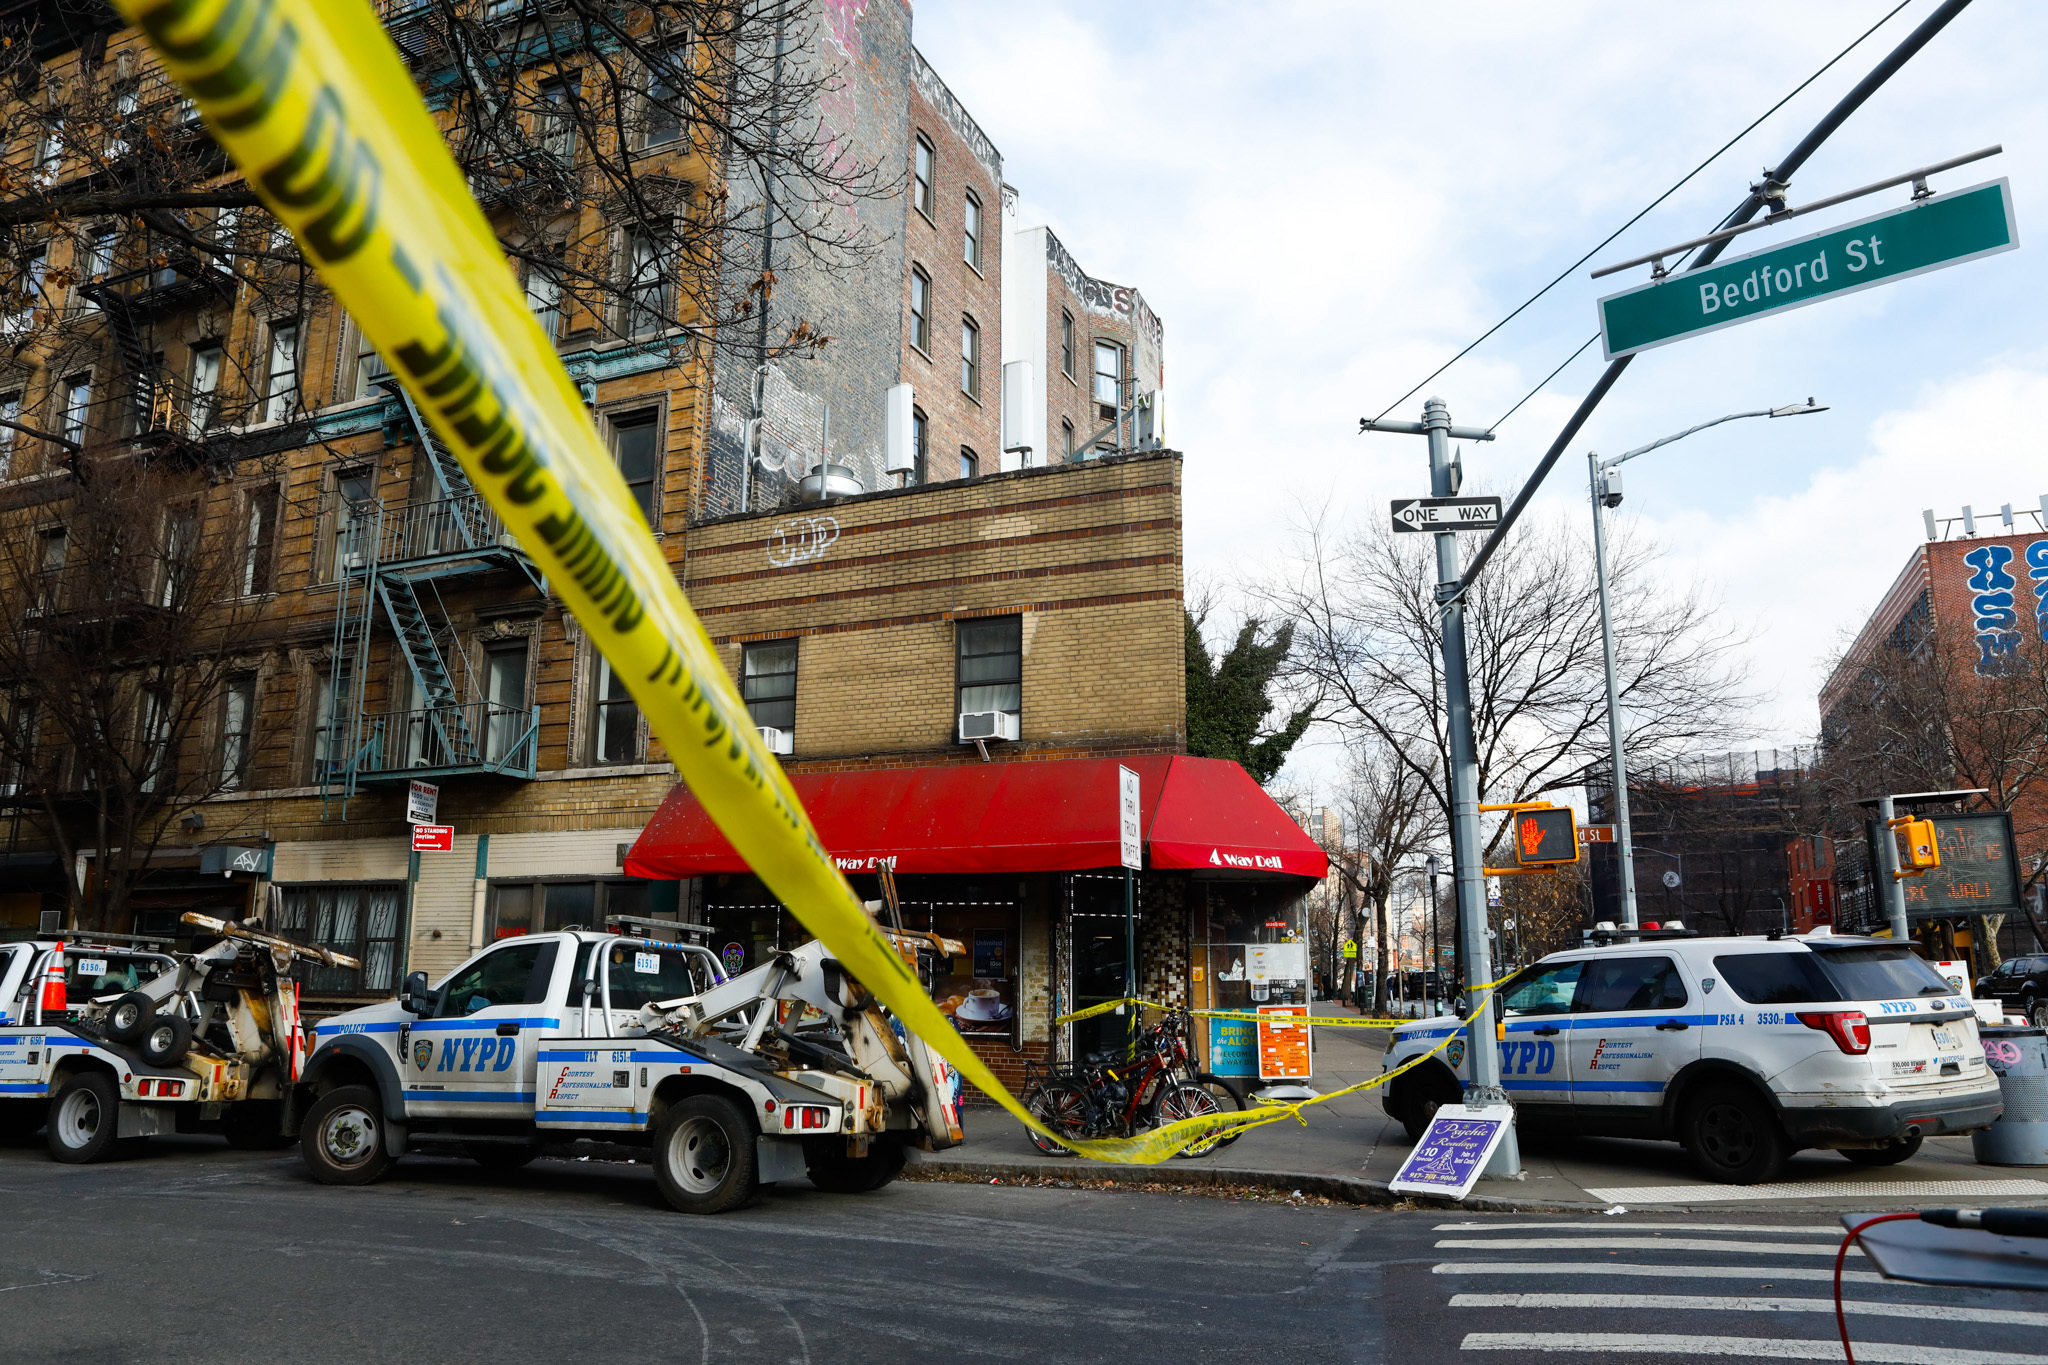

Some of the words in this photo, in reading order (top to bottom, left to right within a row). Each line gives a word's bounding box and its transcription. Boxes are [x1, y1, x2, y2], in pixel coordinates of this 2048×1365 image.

[1700, 250, 1828, 315] Bedford
[1845, 234, 1885, 273] St
[1403, 508, 1439, 523] ONE
[1458, 506, 1492, 521] WAY
[411, 783, 422, 793] FOR
[423, 786, 438, 796] RENT
[1126, 778, 1134, 794] NO
[1124, 797, 1136, 816] THRU
[1123, 819, 1138, 838] TRUCK
[1589, 829, 1601, 841] St
[1122, 841, 1139, 861] TRAFFIC
[836, 858, 866, 870] Way
[867, 855, 898, 873] Deli
[1208, 848, 1223, 866] 4
[1223, 853, 1254, 868] Way
[1255, 855, 1283, 869] Deli
[80, 963, 99, 972] 6150
[637, 958, 653, 969] 6151
[1879, 1001, 1917, 1013] NYPD
[1719, 1013, 1736, 1026] PSA
[1738, 1013, 1745, 1025] 4
[1757, 1013, 1779, 1025] 3530
[339, 1023, 367, 1034] POLICE
[1221, 1026, 1255, 1036] BRING
[1216, 1037, 1228, 1045] the
[1228, 1036, 1258, 1046] ALOH
[1407, 1030, 1432, 1041] POLICE
[1598, 1039, 1633, 1049] COURTESY
[437, 1037, 516, 1072] NYPD
[585, 1051, 598, 1062] FLT
[612, 1051, 627, 1063] 6151
[1497, 1041, 1555, 1075] YPD
[1594, 1049, 1653, 1059] PROFESSIONALISM
[1589, 1059, 1621, 1070] RESPECT
[561, 1066, 595, 1077] COURTESY
[555, 1077, 612, 1088] PROFESSIONALISM
[549, 1089, 579, 1100] RESPECT
[1435, 1123, 1488, 1139] Psychic
[1431, 1137, 1479, 1150] Readings
[1420, 1147, 1438, 1157] $10
